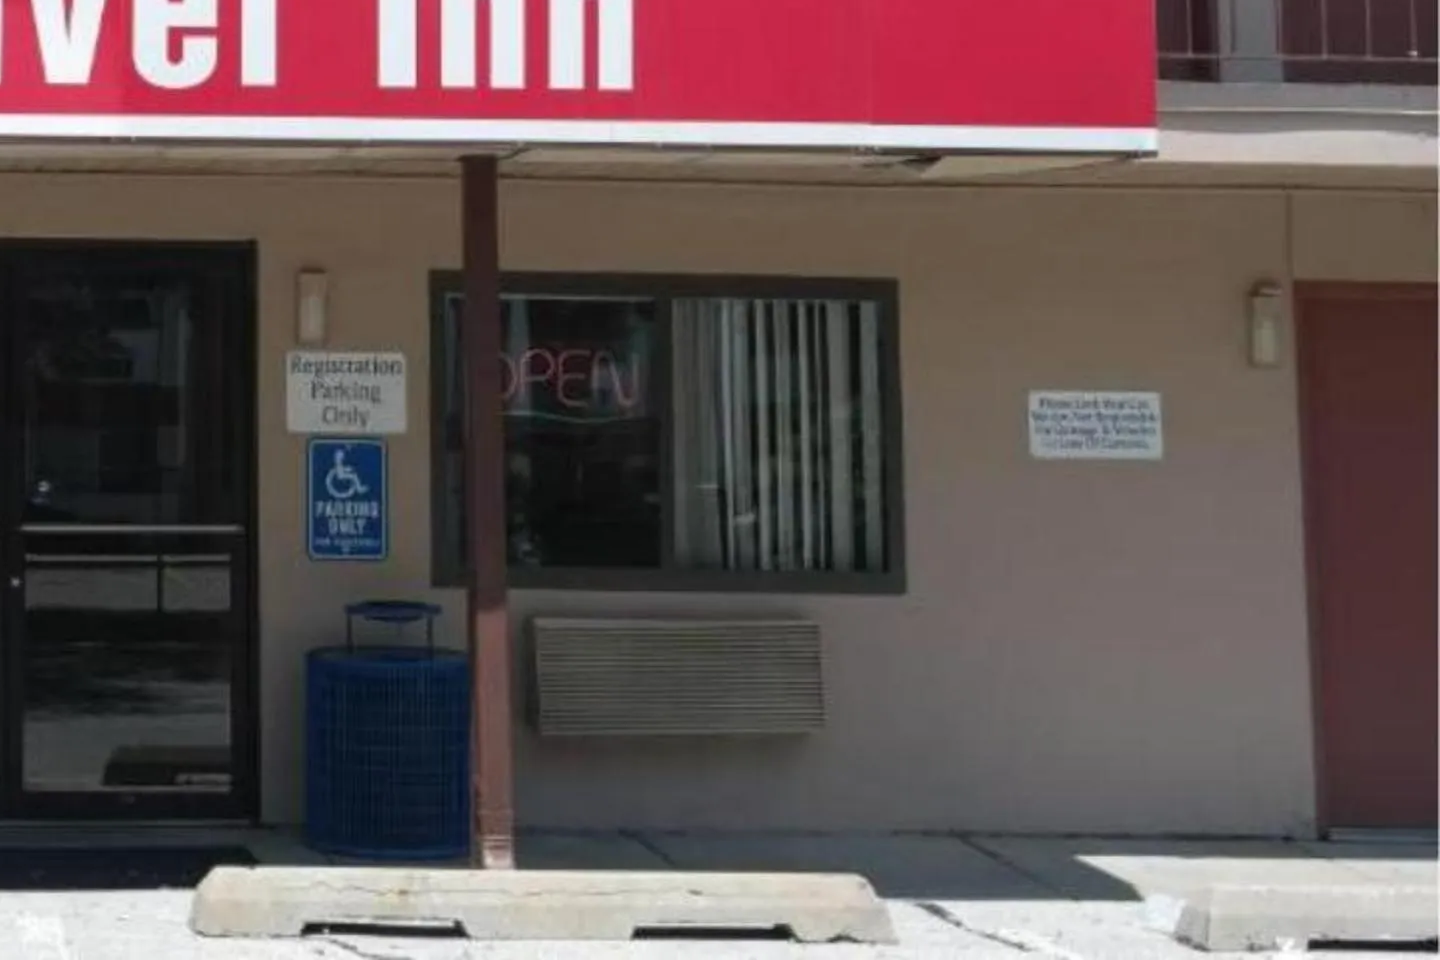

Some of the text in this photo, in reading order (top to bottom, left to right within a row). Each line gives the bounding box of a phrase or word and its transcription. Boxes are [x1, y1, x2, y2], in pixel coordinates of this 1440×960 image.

[291, 355, 403, 378] Registration
[311, 380, 382, 404] Parking
[323, 405, 370, 426] Only
[315, 500, 380, 518] PARKING
[328, 517, 367, 536] ONLY
